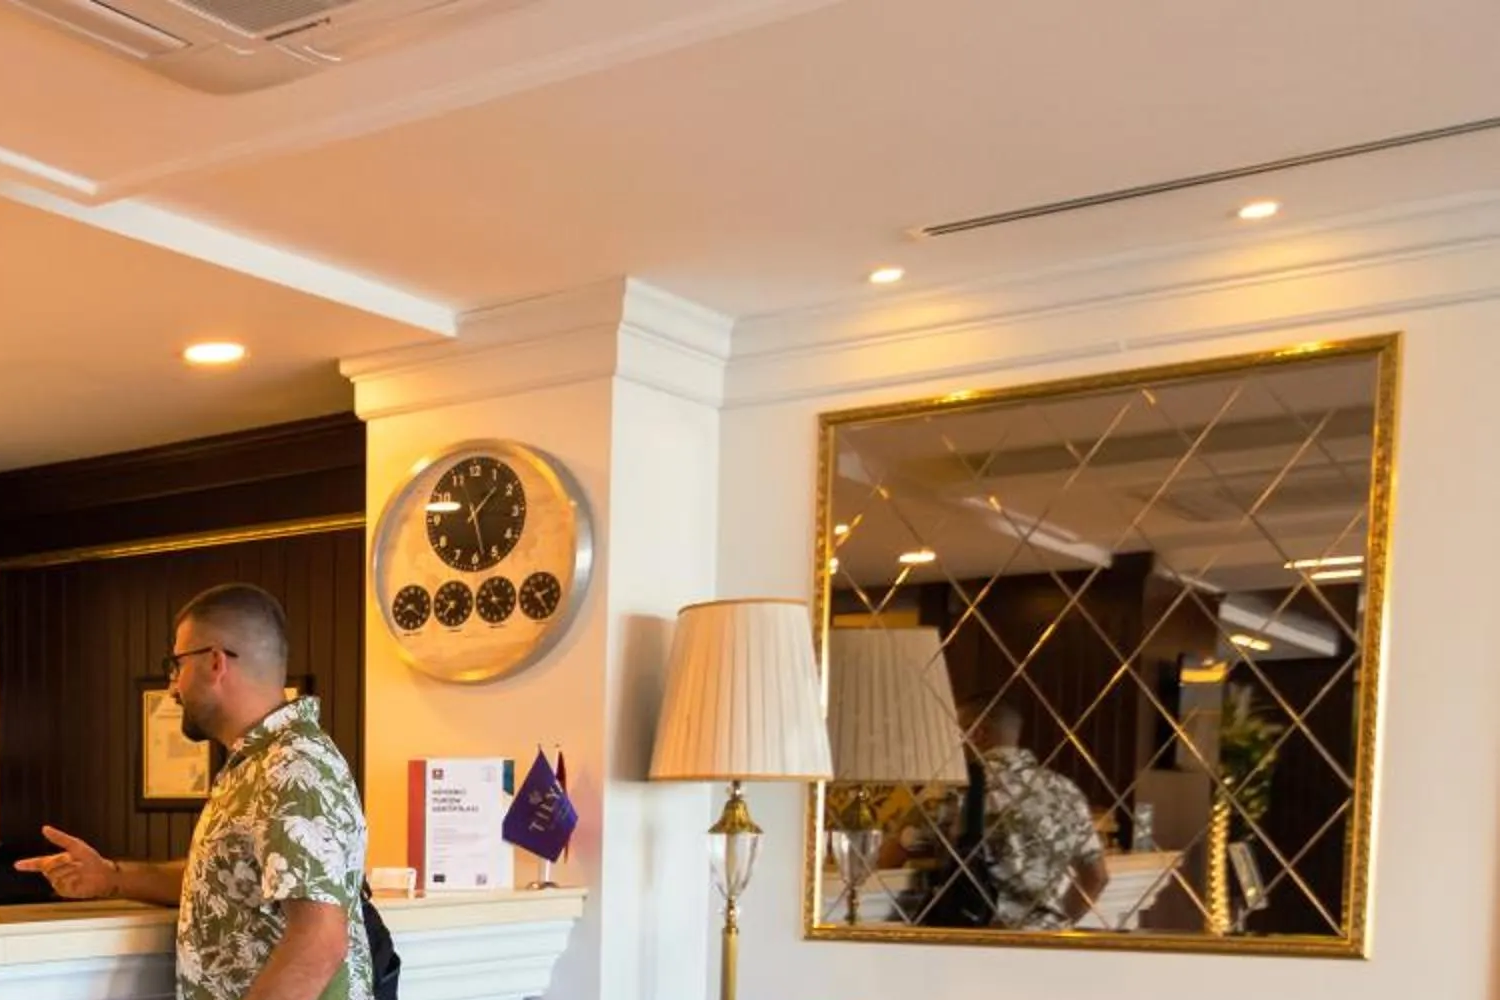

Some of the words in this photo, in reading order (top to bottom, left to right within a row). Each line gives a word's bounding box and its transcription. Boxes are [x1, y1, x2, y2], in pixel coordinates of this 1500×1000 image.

[469, 465, 482, 477] 12
[452, 474, 465, 487] 11
[505, 483, 513, 496] 2
[511, 504, 519, 517] 3
[433, 514, 441, 526] 9
[504, 527, 513, 539] 4
[440, 535, 447, 548] 8
[454, 549, 461, 561] 7
[491, 545, 498, 557] 5
[471, 552, 479, 564] 6
